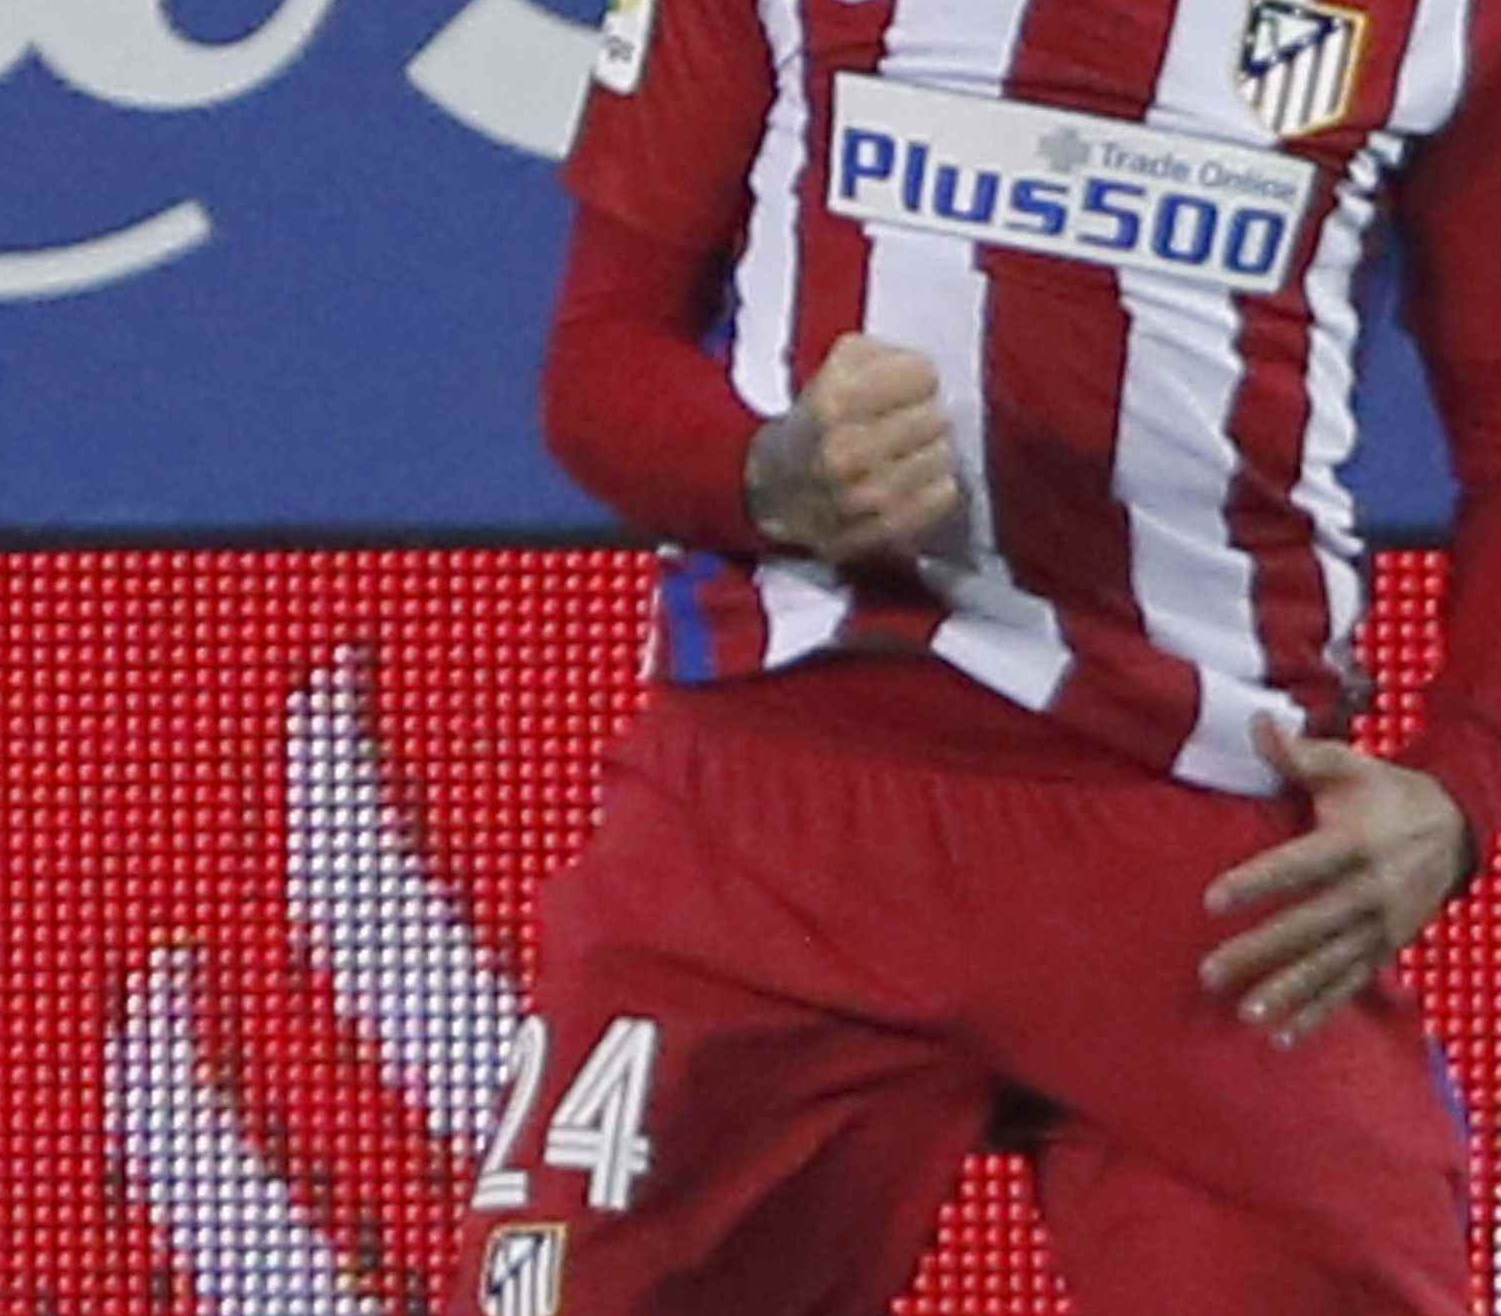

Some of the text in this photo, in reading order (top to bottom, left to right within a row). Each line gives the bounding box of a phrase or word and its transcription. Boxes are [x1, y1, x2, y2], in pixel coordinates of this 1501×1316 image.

[840, 125, 1286, 277] Plus500
[1100, 141, 1193, 183] Trade
[470, 1015, 658, 1212] 24
